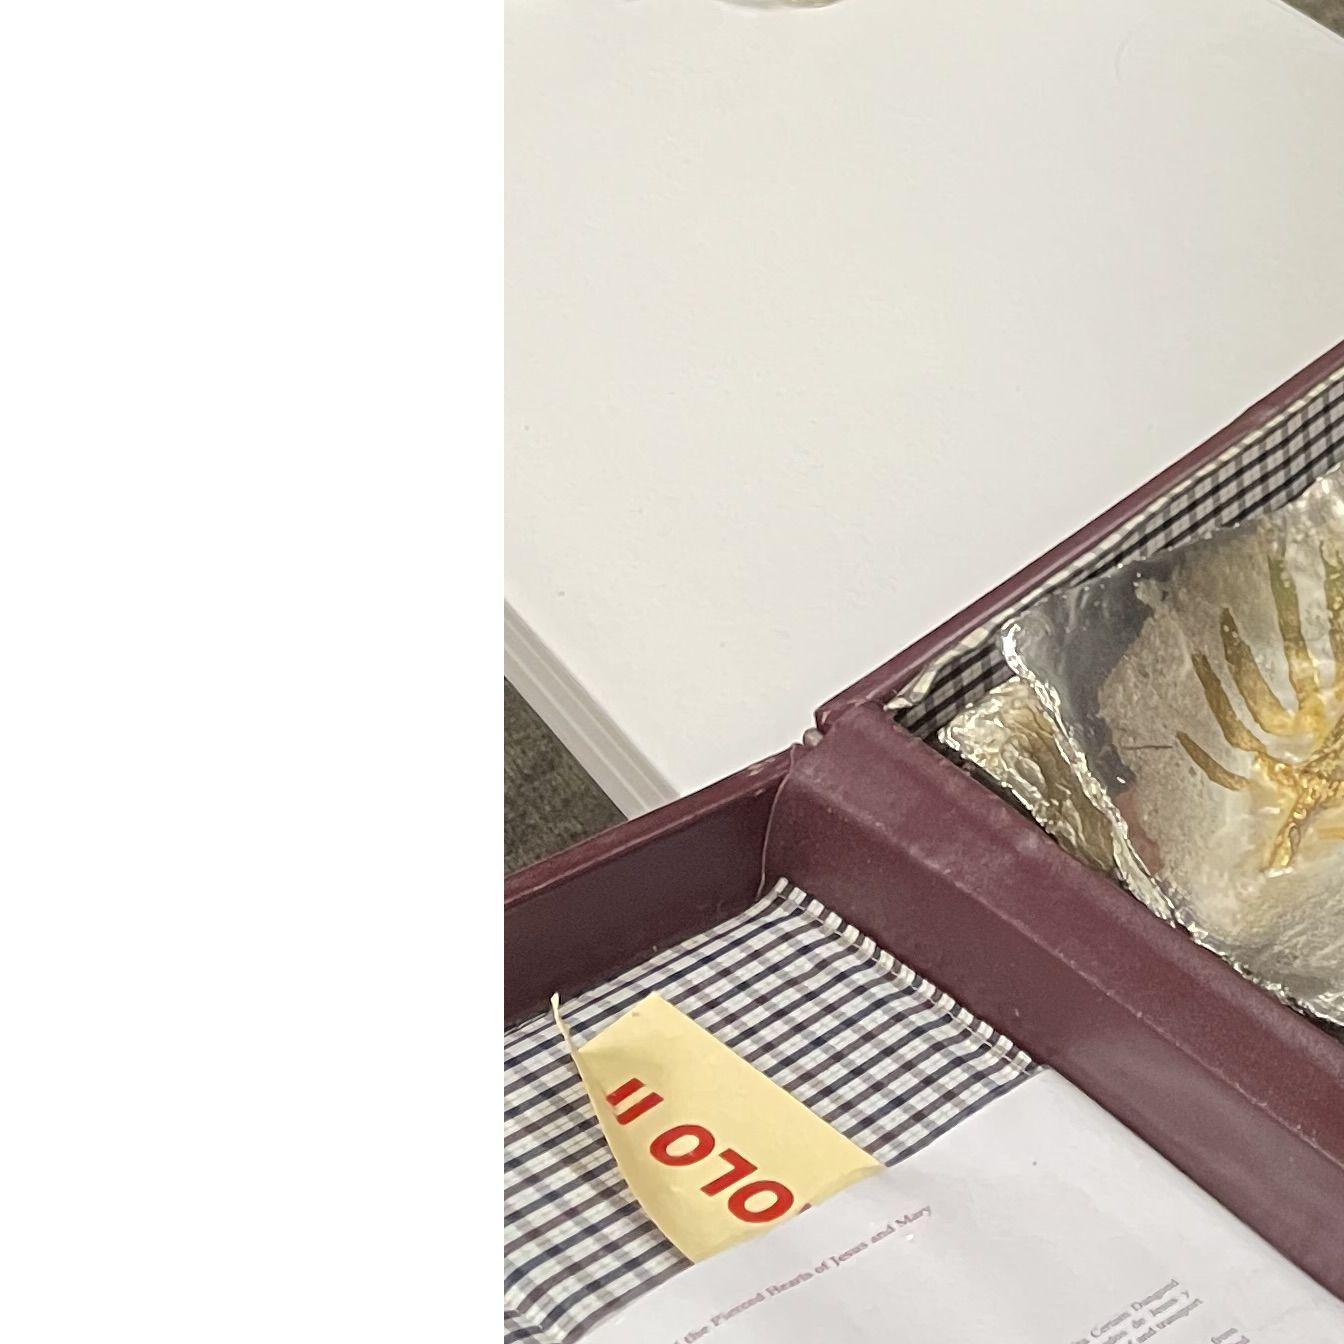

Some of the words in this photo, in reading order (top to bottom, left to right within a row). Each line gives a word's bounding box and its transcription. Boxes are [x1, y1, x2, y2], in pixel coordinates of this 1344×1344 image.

[650, 1123, 811, 1223] OLO
[829, 1241, 869, 1268] Jesus
[871, 1223, 896, 1244] and
[895, 1205, 932, 1228] Mary
